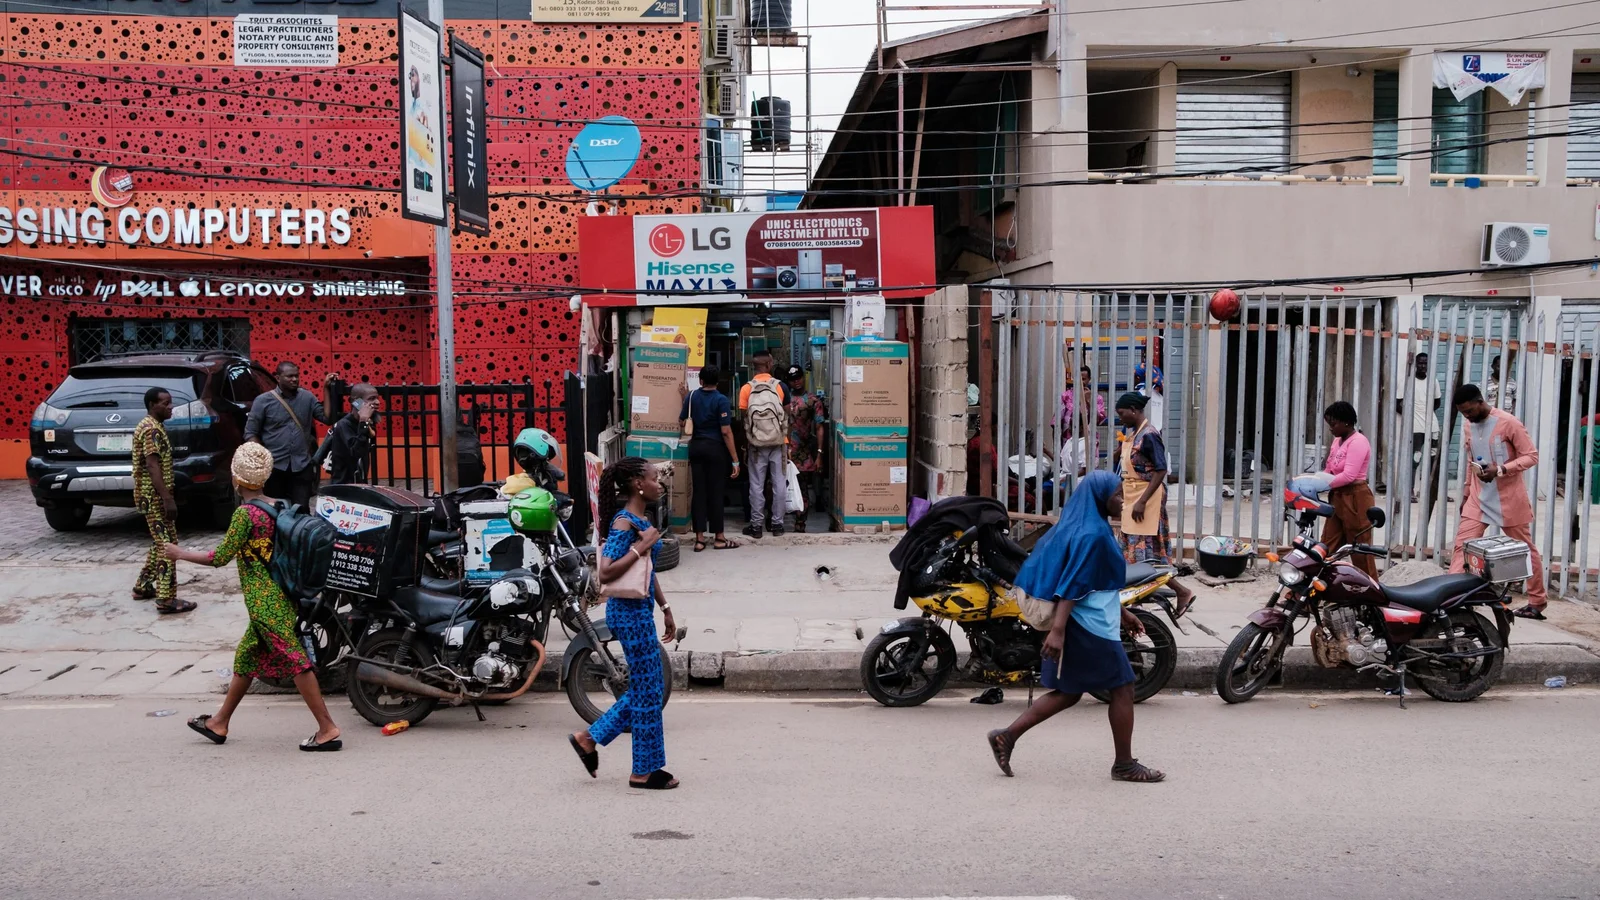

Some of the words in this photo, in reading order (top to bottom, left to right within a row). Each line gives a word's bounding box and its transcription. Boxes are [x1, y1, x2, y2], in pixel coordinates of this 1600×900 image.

[654, 2, 666, 11] 24
[0, 206, 105, 244] SSING
[118, 206, 352, 244] COMPUTERS
[766, 220, 791, 229] UNIC
[794, 217, 862, 228] ELECTRONICS
[692, 227, 731, 250] LG
[760, 228, 825, 240] INVESTMENT
[828, 228, 849, 238] INTL
[852, 227, 869, 237] LTD
[647, 262, 734, 276] Hisense
[93, 280, 117, 302] hp
[122, 280, 174, 297] DELL
[205, 280, 304, 296] Lenovo
[312, 280, 405, 296] SAMSUNG
[646, 278, 713, 291] MAXI
[640, 349, 679, 358] Hisense
[853, 444, 898, 452] Hisense
[339, 520, 359, 530] 24/7
[337, 552, 348, 560] 806
[360, 557, 375, 565] 7706
[336, 560, 346, 568] 912
[358, 565, 372, 574] 3303
